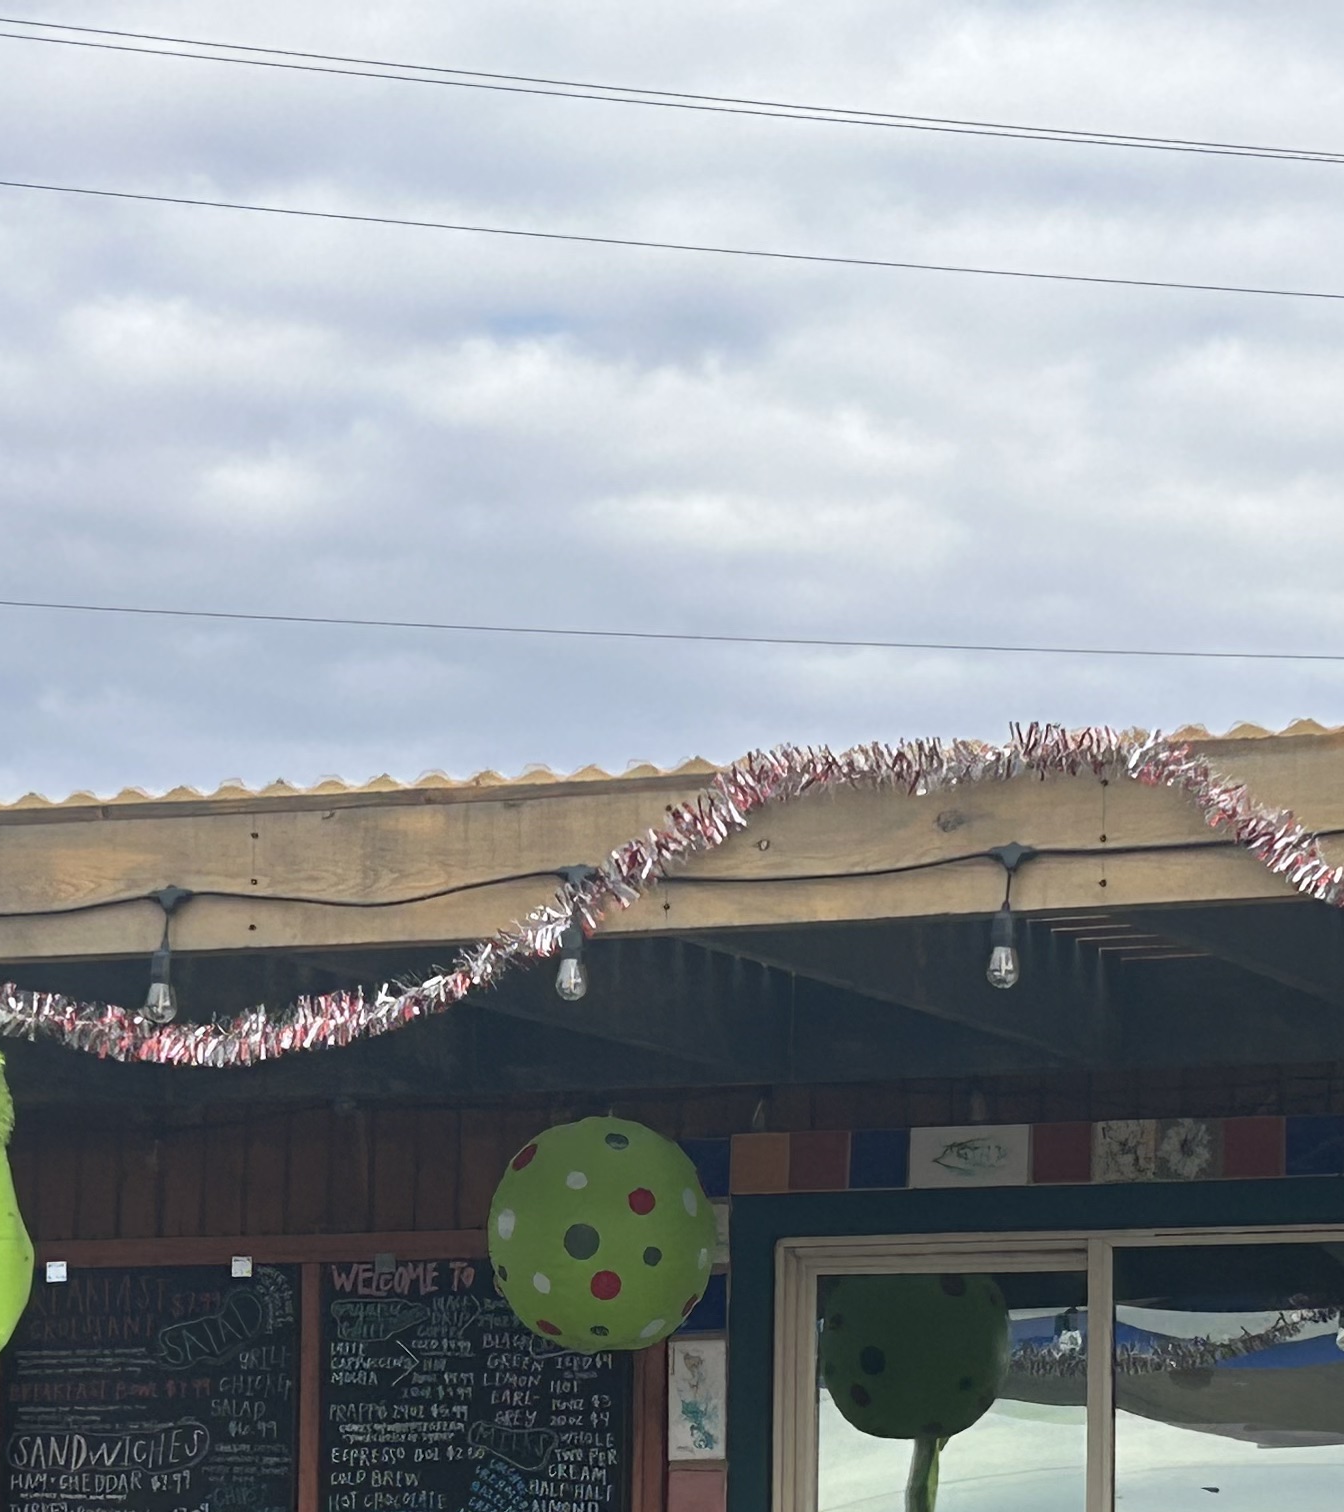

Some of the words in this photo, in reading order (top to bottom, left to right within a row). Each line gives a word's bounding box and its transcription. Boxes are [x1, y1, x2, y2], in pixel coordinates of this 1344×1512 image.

[330, 1262, 440, 1297] WELCOME
[449, 1262, 475, 1292] TO
[13, 1428, 205, 1473] SANDWICHES
